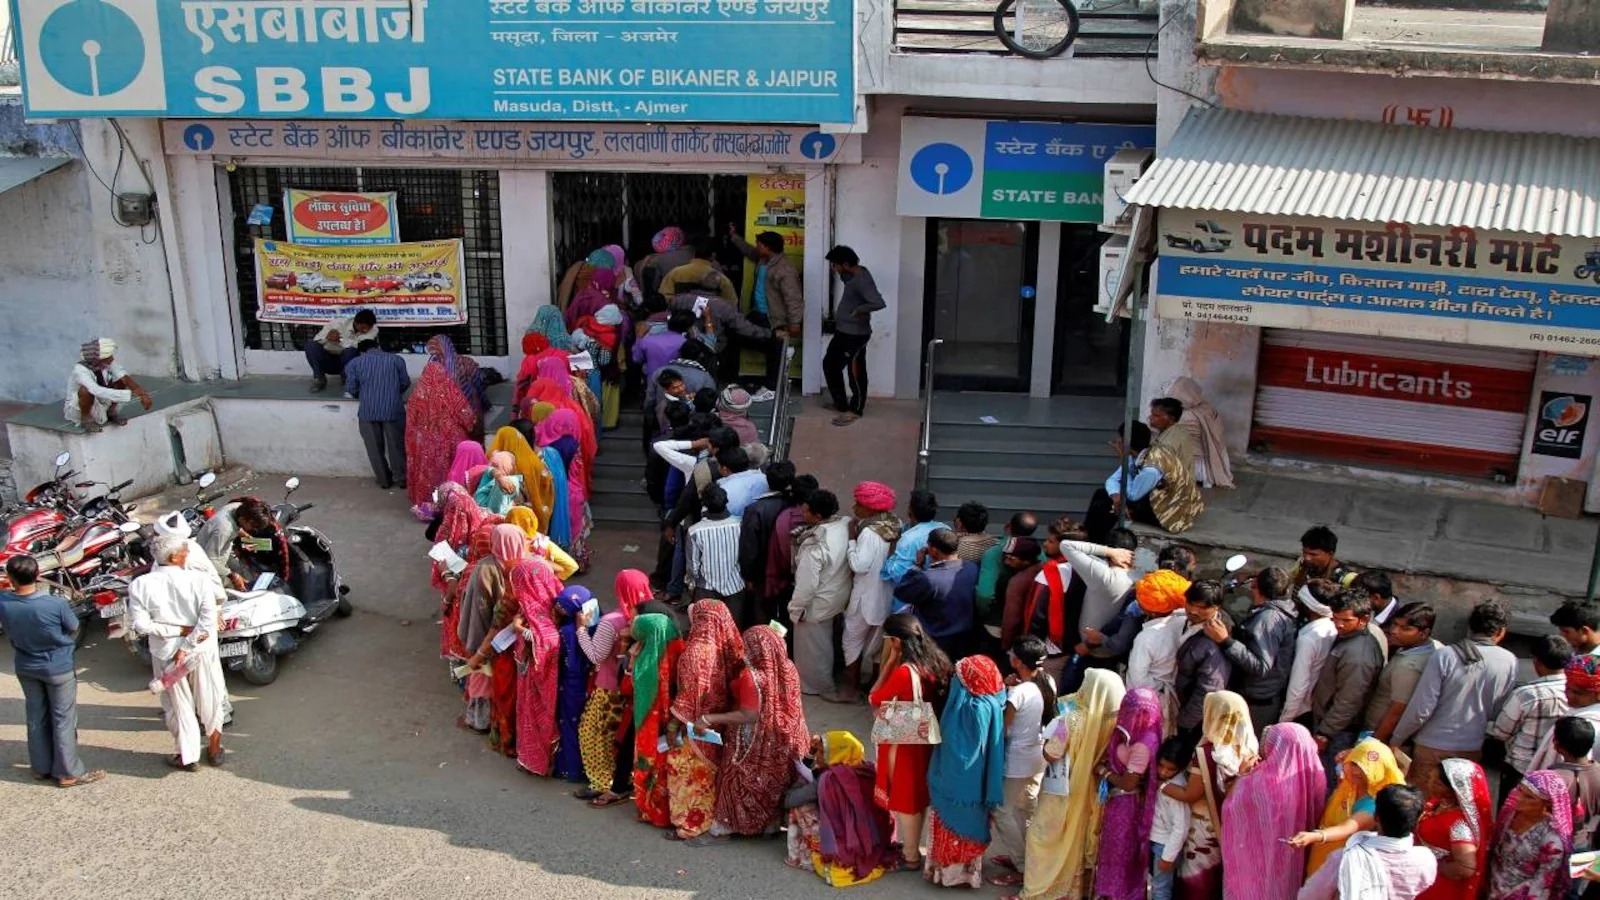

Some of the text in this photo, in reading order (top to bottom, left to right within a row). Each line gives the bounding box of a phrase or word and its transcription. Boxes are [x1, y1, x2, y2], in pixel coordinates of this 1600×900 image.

[489, 0, 529, 14] स्टट
[764, 0, 830, 21] जयपुर
[181, 0, 428, 54] एसबीबीज
[489, 31, 545, 47] मसूदा,
[551, 28, 599, 43] जिला
[620, 27, 679, 43] अजमेर
[493, 68, 838, 88] STATE BANK OF BIKANER & JAIPUR
[193, 65, 431, 115] SBBJ
[493, 100, 567, 114] Masuda,
[634, 100, 688, 116] Ajmer
[228, 122, 274, 147] स्टेट
[282, 122, 319, 149] बैंक
[325, 124, 371, 149] ऑफ
[380, 120, 466, 151] बीकानेर
[473, 129, 522, 152] एण्ड
[527, 130, 600, 159] जयपुर,
[603, 125, 669, 155] ललवाणी
[995, 137, 1038, 155] स्टेट
[1045, 138, 1085, 157] बैंक
[1091, 145, 1107, 159] ए
[308, 199, 371, 215] लॉकर सुविधा
[992, 189, 1057, 204] STATE
[316, 219, 352, 231] उपलब्ध
[1242, 219, 1562, 275] पदम मशीनरी मार्ट
[1179, 264, 1221, 277] हमारे
[1262, 270, 1288, 282] पर
[1291, 271, 1335, 287] जीप,
[1339, 273, 1405, 290] किसान
[1457, 284, 1496, 298] टाटा
[1241, 285, 1294, 298] स्पेयर
[1349, 294, 1362, 305] व
[1367, 294, 1425, 309] आयल
[1429, 298, 1468, 314] ग्रीस
[1471, 300, 1526, 319] मिलते
[1529, 333, 1544, 341] (R)
[1305, 356, 1473, 400] Lubricants
[1539, 428, 1580, 444] elf
